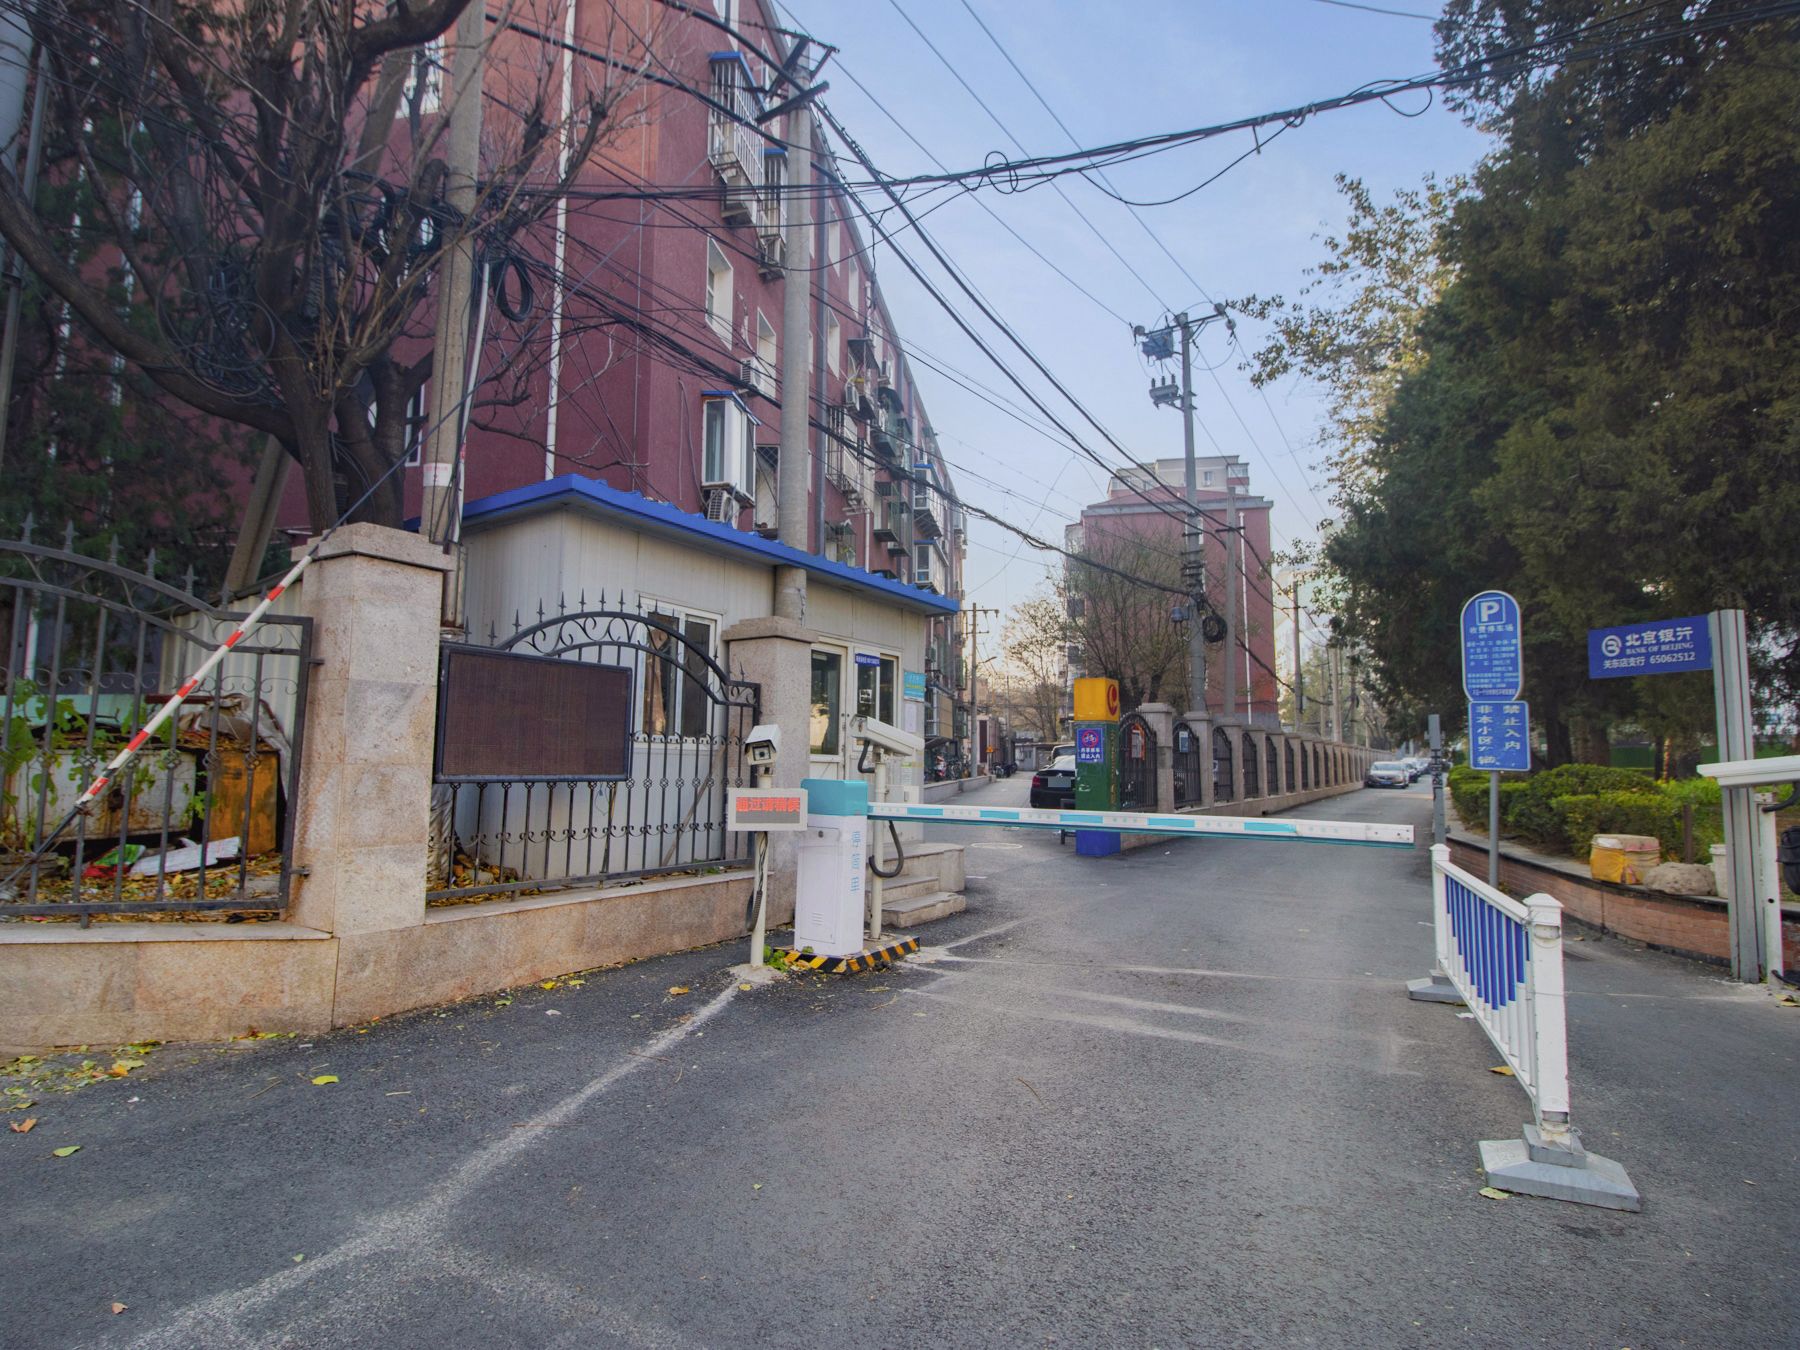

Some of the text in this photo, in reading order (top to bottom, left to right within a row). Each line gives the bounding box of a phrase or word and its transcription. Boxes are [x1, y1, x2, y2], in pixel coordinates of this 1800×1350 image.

[1481, 602, 1500, 622] P
[1625, 627, 1693, 646] 北京银行
[1626, 646, 1647, 655] BANK
[1661, 641, 1694, 651] BEIJING
[1649, 651, 1696, 664] 65062512
[1503, 705, 1521, 751] 禁止入内
